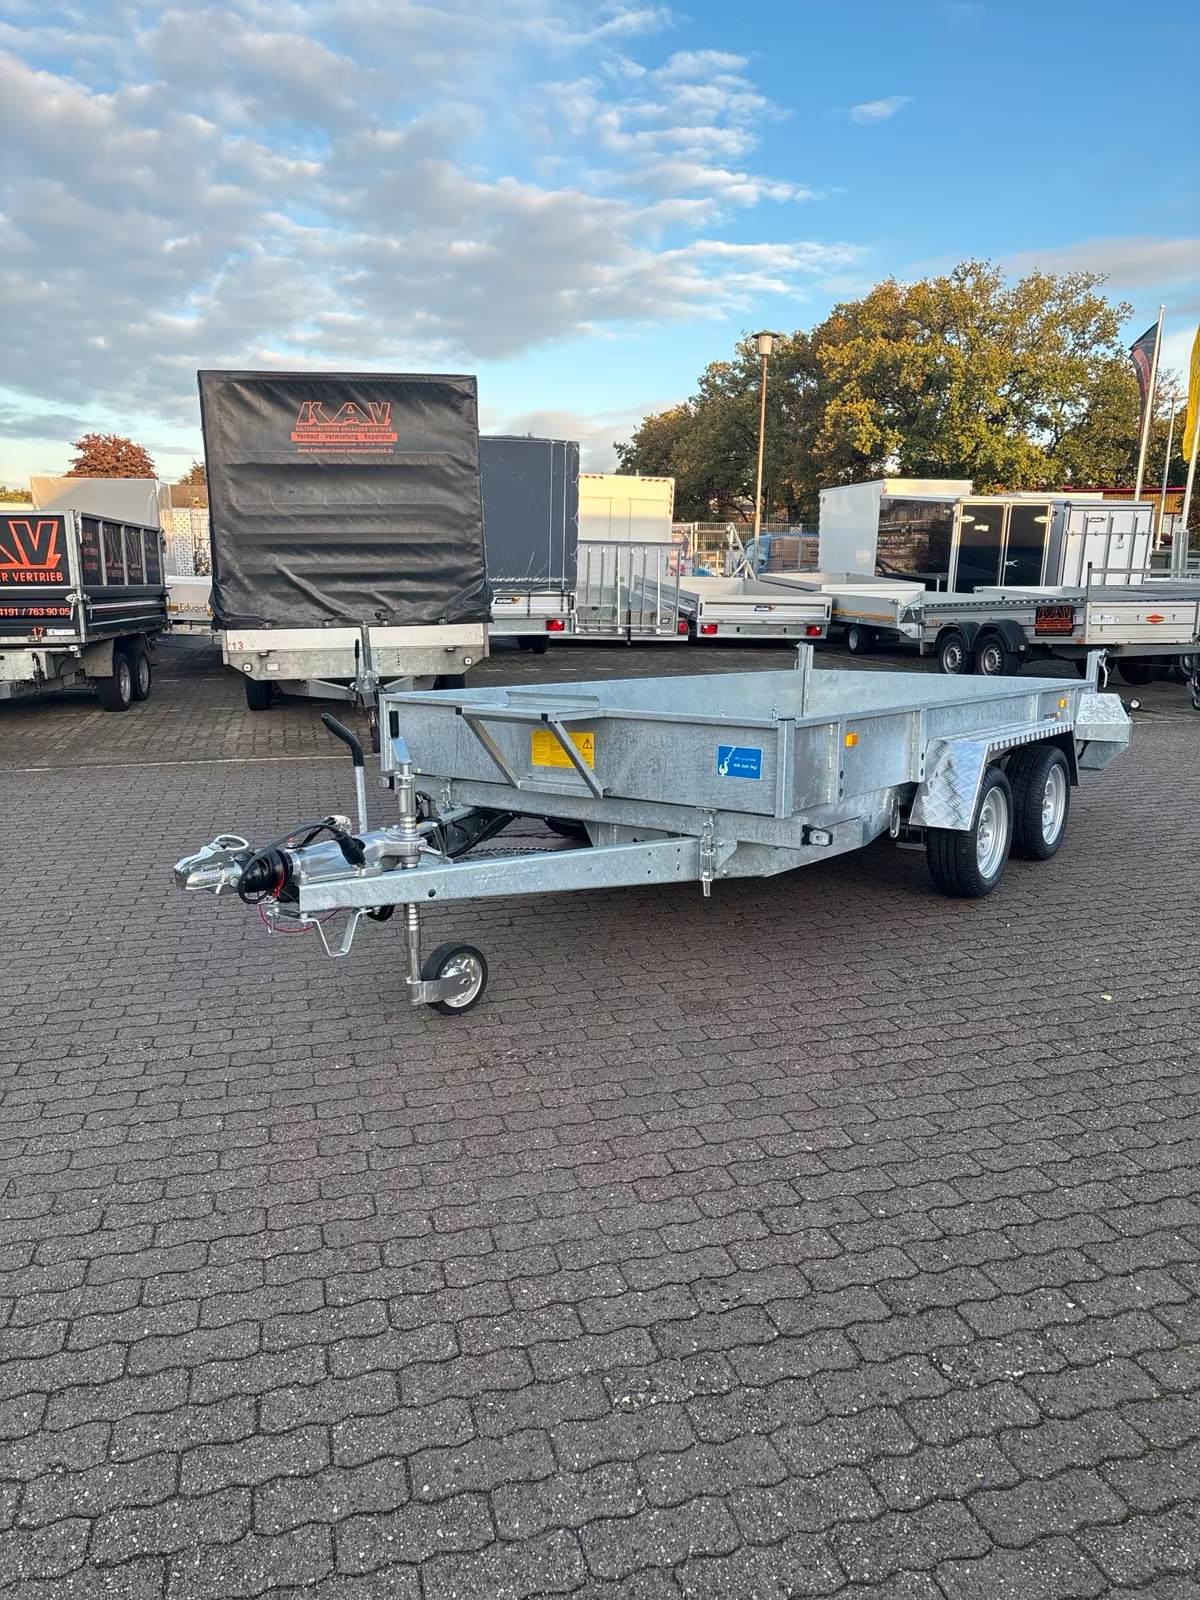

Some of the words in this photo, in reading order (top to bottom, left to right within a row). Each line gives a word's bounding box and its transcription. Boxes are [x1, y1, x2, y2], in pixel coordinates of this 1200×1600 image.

[296, 401, 391, 426] KAV
[12, 572, 64, 582] VERTRIEB
[28, 607, 44, 616] 763
[46, 607, 57, 616] 90
[60, 607, 71, 616] 05
[31, 627, 44, 637] 17
